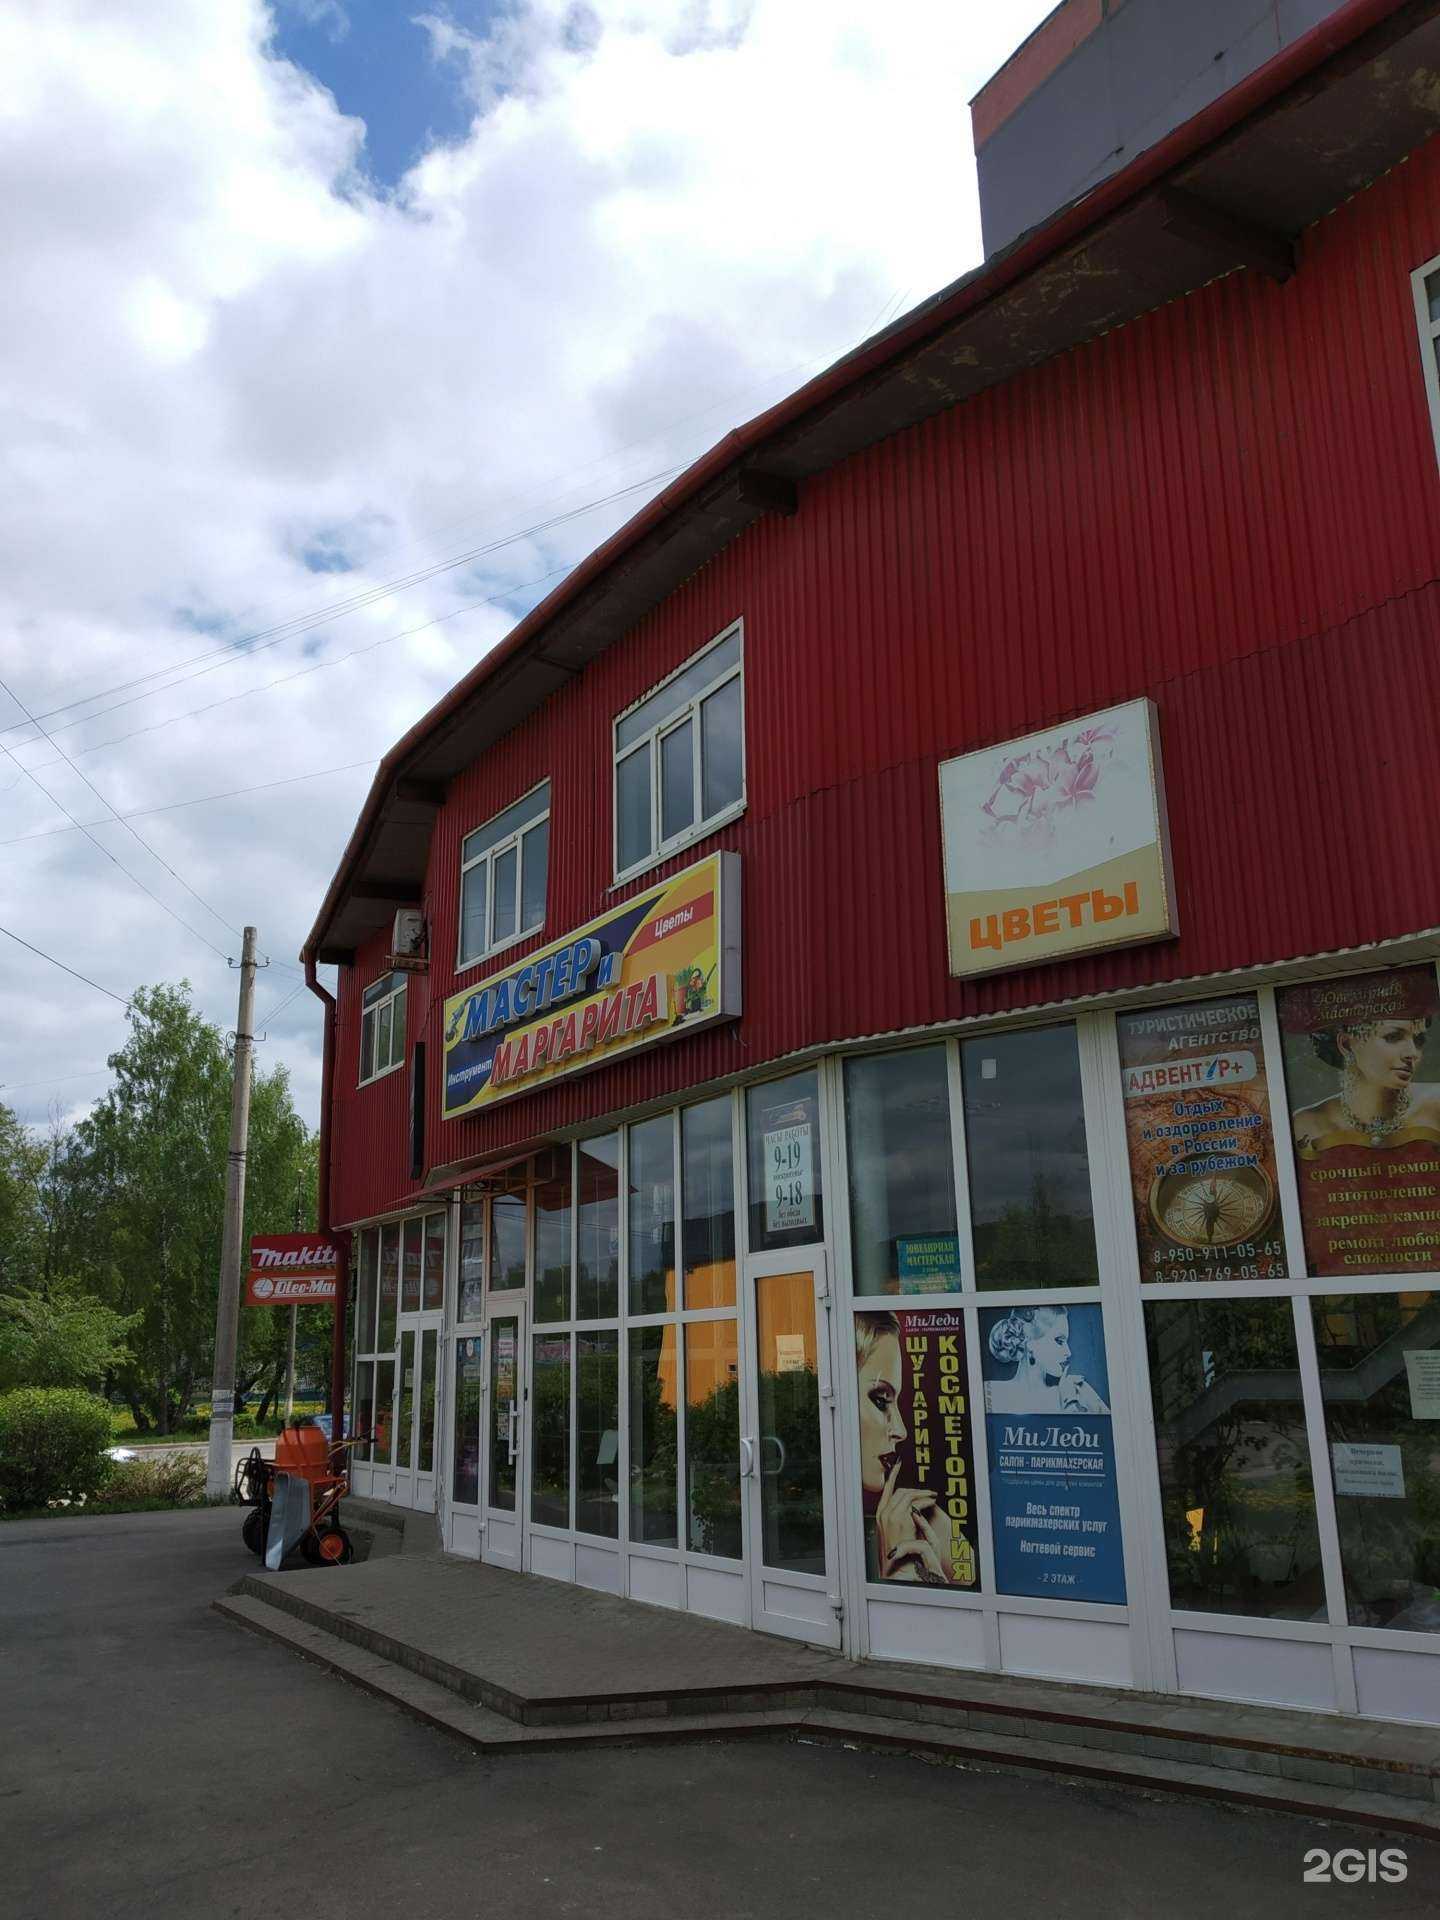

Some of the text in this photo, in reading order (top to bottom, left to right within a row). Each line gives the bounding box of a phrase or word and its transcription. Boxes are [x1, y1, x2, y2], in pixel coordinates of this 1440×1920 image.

[654, 906, 693, 938] Цветы
[970, 881, 1139, 950] ЦВЕТЫ
[462, 937, 601, 1042] МАСТЕР
[490, 972, 665, 1087] МАРГАРИТА
[1128, 1004, 1259, 1035] ТУРИСТИЧЕСКОЕ
[1168, 1028, 1261, 1050] АГЕНТСТВО
[448, 1057, 493, 1087] Инструмент
[1174, 1099, 1224, 1117] Отдых
[1143, 1114, 1263, 1140] и оздоровление
[774, 1141, 801, 1173] 9-19
[1172, 1138, 1238, 1155] в России
[1156, 1154, 1258, 1176] и за рубежом
[1311, 1163, 1382, 1184] срочный
[776, 1181, 803, 1208] 9-18
[1328, 1185, 1437, 1204] изготовление
[1154, 1241, 1282, 1263] 8-950-911-05-65
[1328, 1237, 1385, 1255] ремонт
[1344, 1251, 1433, 1265] сложности
[1156, 1264, 1285, 1283] 8-920-769-05-65
[905, 1336, 932, 1482] ШУГАРИНГ
[938, 1335, 973, 1582] КОСМЕТОЛОГИЯ
[999, 1456, 1025, 1468] САЛОН
[1031, 1456, 1104, 1471] ПАРИКМАХЕРСКАЯ
[1026, 1502, 1081, 1519] Весь спектр
[1006, 1516, 1108, 1534] парикмахерских услуг
[1020, 1539, 1097, 1558] Ногтевой сервис
[1051, 1574, 1076, 1587] ЭТАЖ
